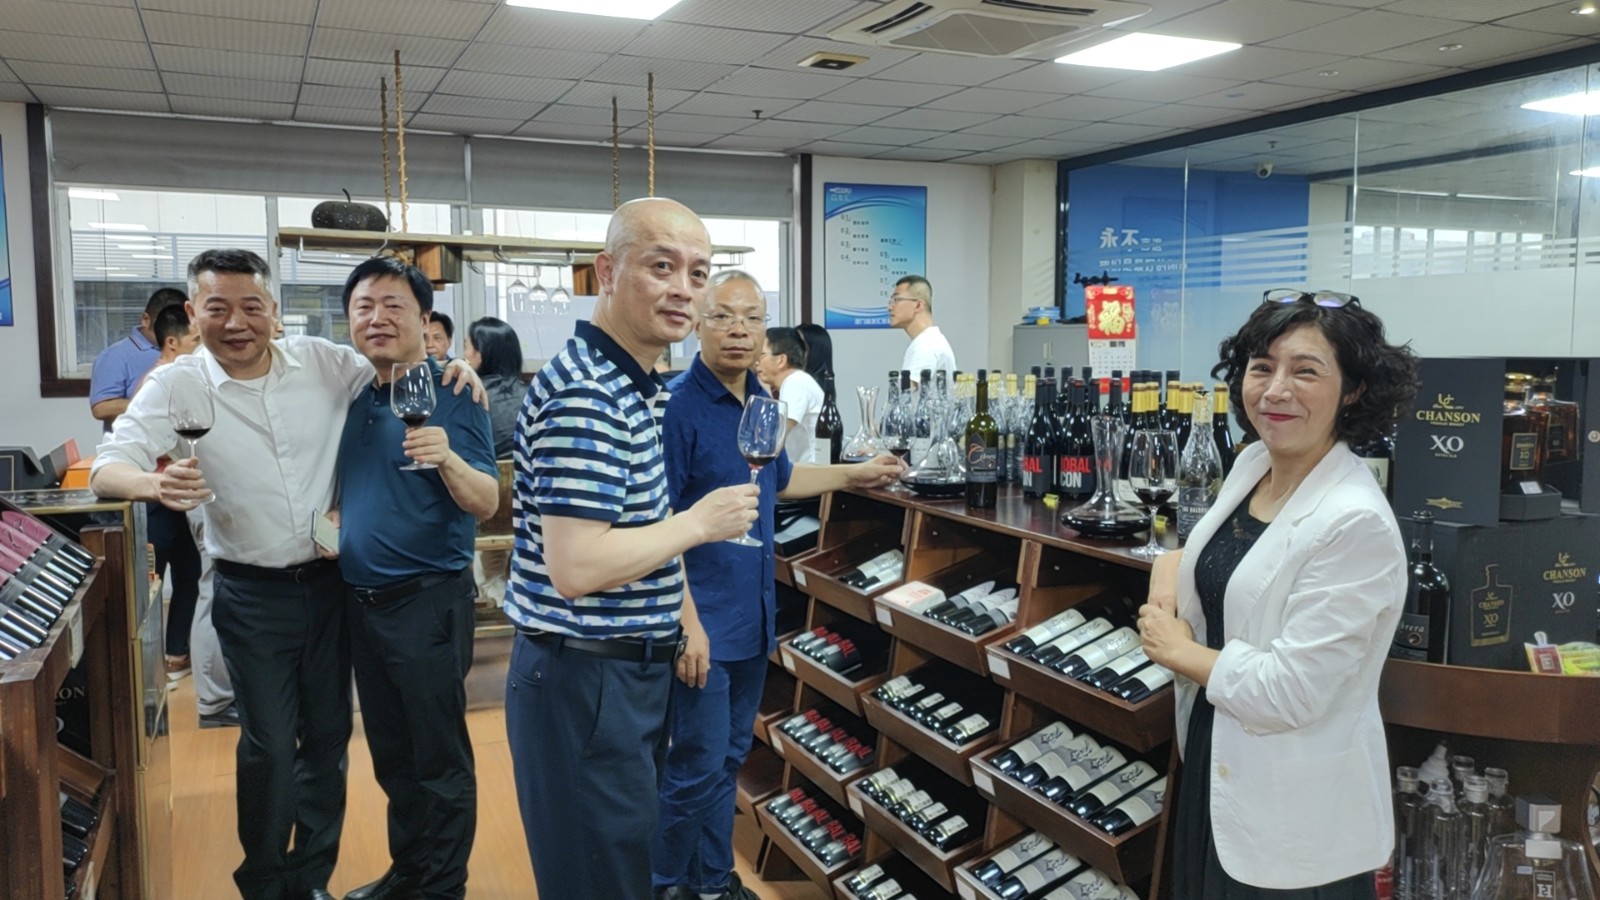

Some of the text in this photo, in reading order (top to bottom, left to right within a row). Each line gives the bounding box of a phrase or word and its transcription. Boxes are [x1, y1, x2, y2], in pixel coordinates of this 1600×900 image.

[1098, 300, 1126, 335] 福
[1416, 410, 1481, 424] CHANSON
[1429, 434, 1464, 455] XO
[1542, 567, 1587, 581] CHANSON
[1551, 591, 1576, 610] XO
